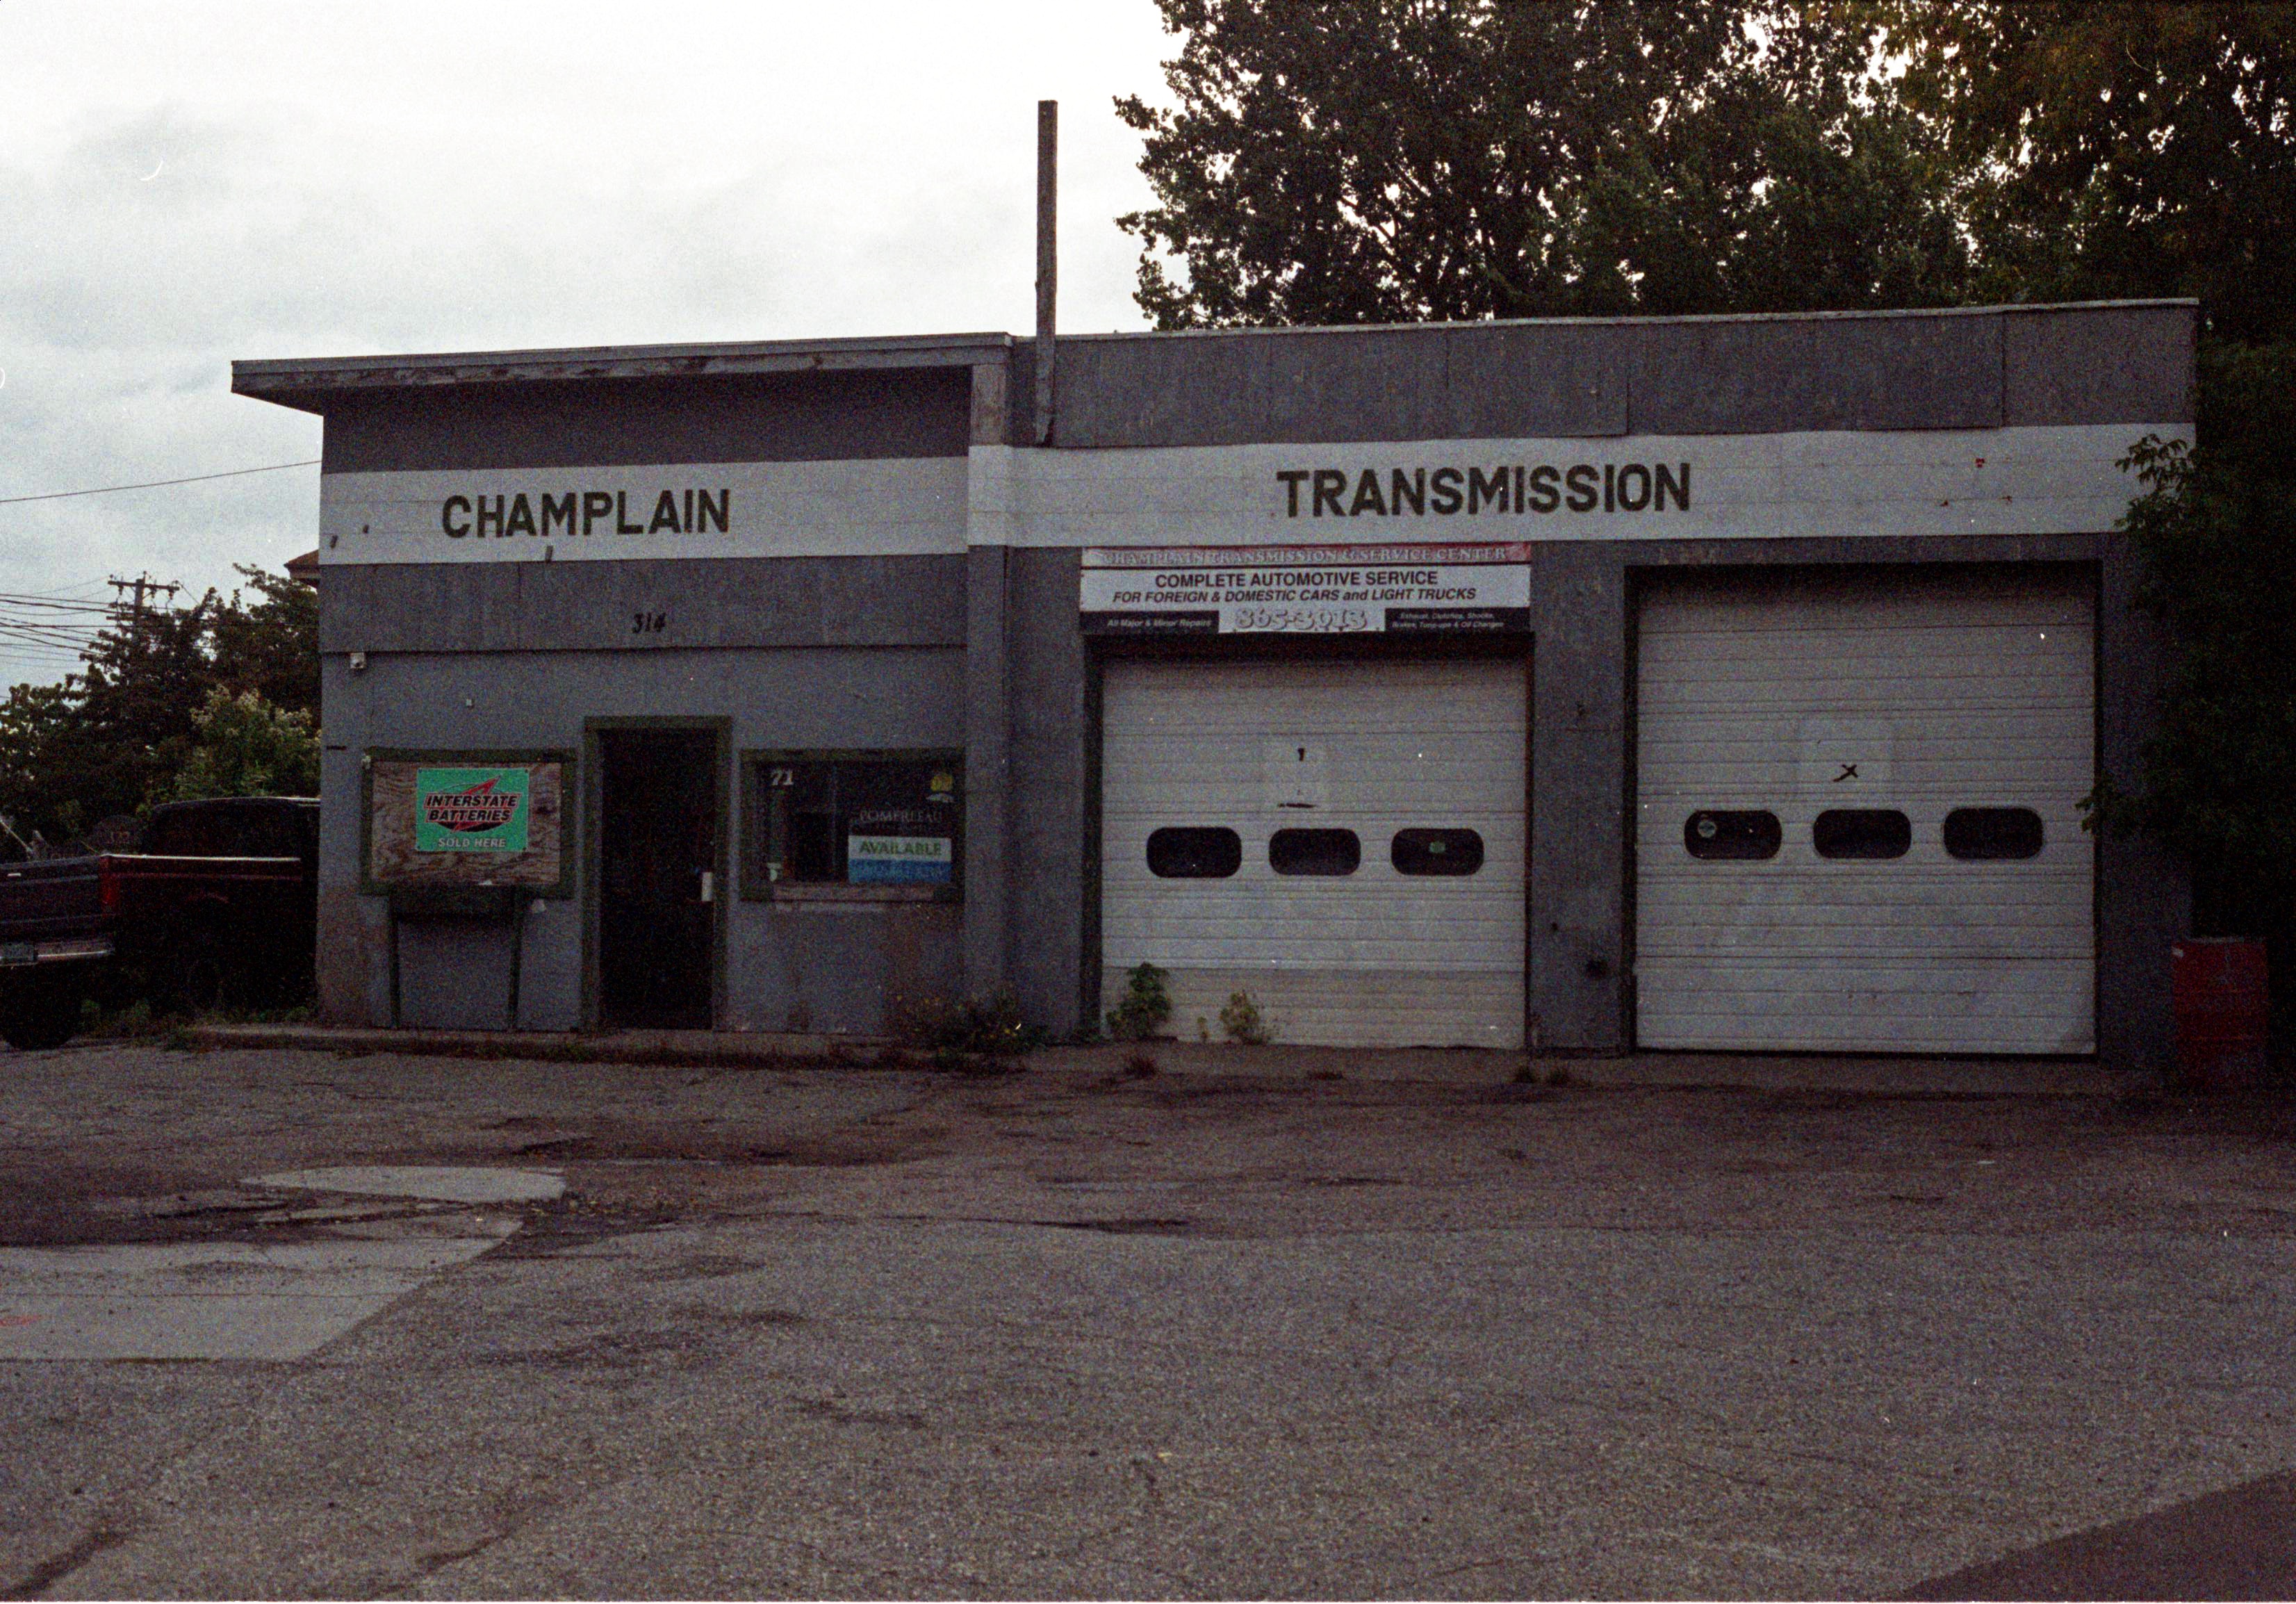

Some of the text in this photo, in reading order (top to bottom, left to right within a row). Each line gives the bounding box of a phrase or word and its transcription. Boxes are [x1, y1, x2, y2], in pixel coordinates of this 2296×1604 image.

[1277, 463, 1691, 518] TRANSMISSION
[442, 489, 730, 538] CHAMPLAIN
[1103, 550, 1205, 565] CHAMPLAIN
[1209, 549, 1337, 564] TRANSMISSION
[1361, 549, 1432, 561] SERVICE
[1436, 548, 1506, 559] CENTER
[1156, 571, 1438, 588] COMPLETE AUTOMOTIVE SERVICE
[1113, 588, 1477, 603] FOR FOREIGN & DOMESTIC CARS and LIGHT TRUCKS
[426, 794, 518, 808] INTERSTATE
[428, 808, 511, 822] BATTERIES
[438, 837, 507, 848] SOLD HERE
[859, 841, 943, 856] AVAILABLE
